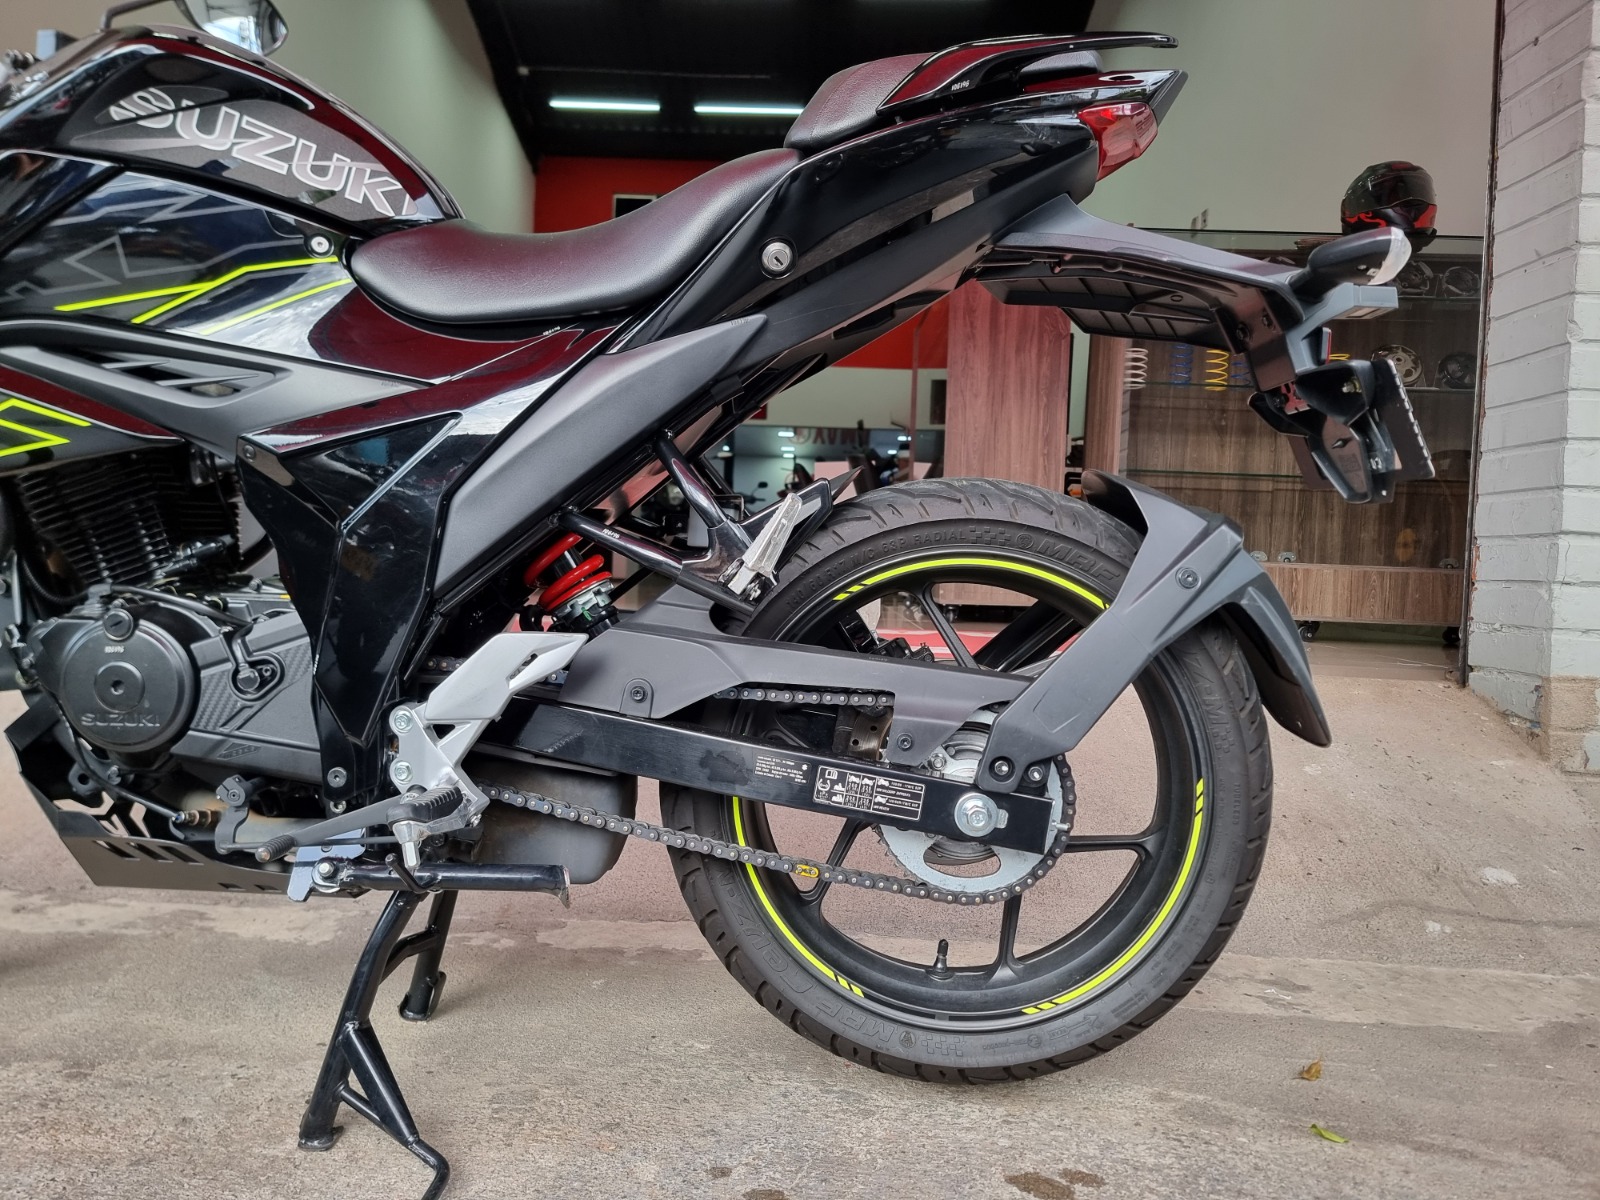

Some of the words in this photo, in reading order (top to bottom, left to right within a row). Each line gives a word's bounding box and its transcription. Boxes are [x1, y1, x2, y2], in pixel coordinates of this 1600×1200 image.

[913, 528, 967, 545] RADIAL
[1036, 538, 1121, 581] MRF
[81, 713, 160, 727] SUZUKI
[815, 1001, 897, 1043] MRF
